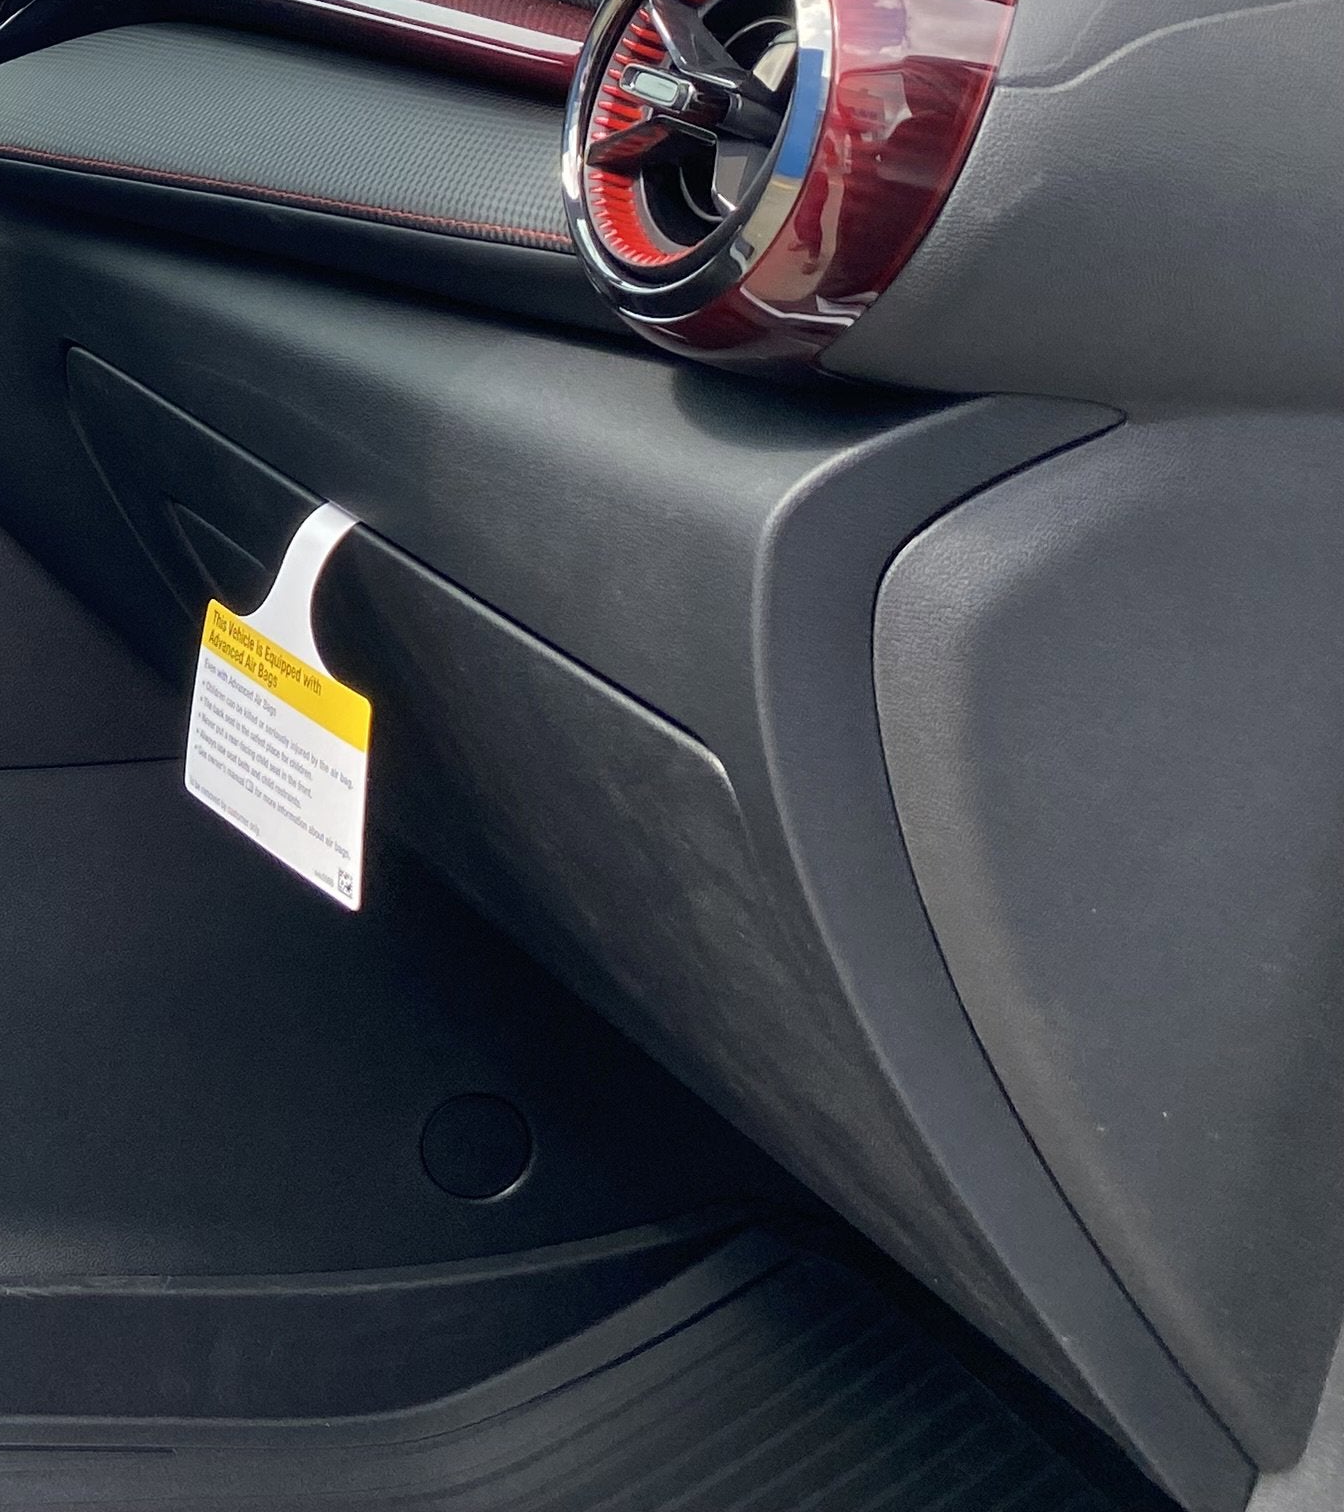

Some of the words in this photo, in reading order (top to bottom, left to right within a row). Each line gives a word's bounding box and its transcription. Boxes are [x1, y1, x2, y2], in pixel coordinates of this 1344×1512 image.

[208, 629, 243, 664] Advanced
[244, 654, 256, 673] Air
[258, 663, 278, 689] Bags
[213, 610, 227, 632] This
[228, 621, 254, 651] Vehicle
[265, 646, 301, 682] Equipped
[304, 672, 322, 696] with
